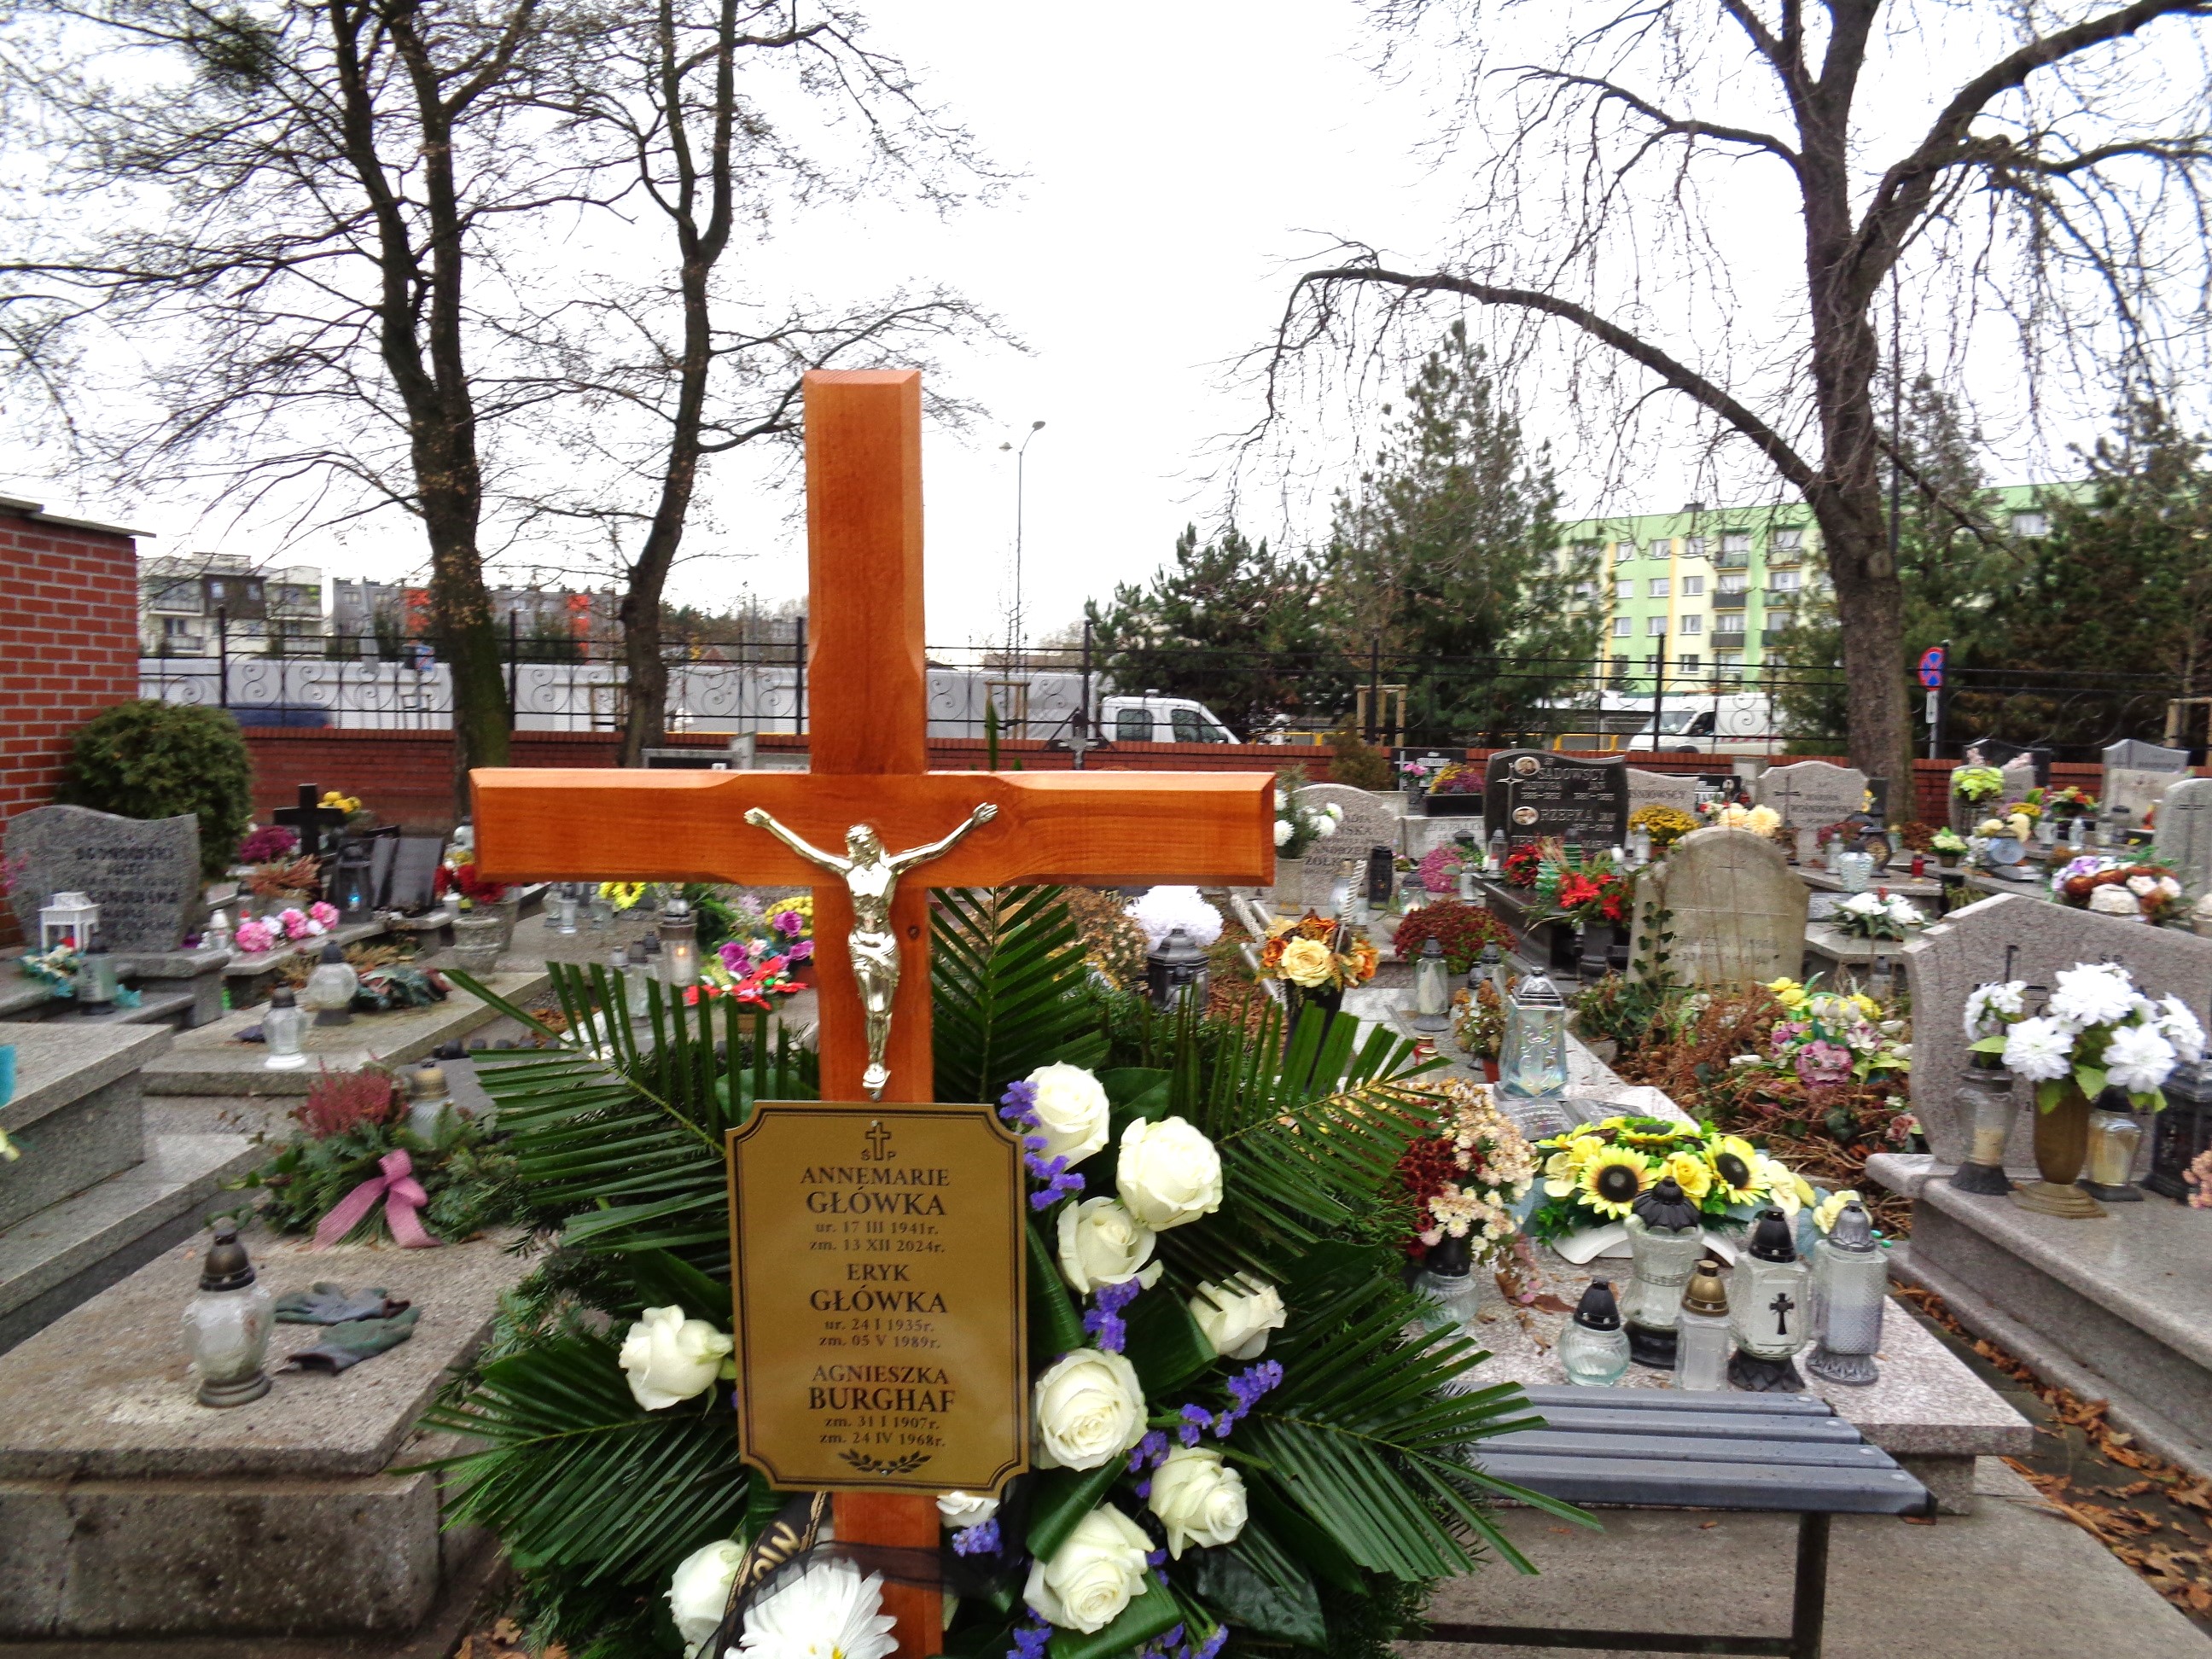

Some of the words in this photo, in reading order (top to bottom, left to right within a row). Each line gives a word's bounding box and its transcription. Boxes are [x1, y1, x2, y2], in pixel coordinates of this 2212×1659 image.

[800, 1167, 951, 1186] ANNEMARIE
[806, 1186, 947, 1216] GŁÓWKA
[815, 1222, 835, 1234] ur.
[843, 1221, 859, 1234] 17
[866, 1221, 883, 1234] III
[892, 1221, 939, 1235] 1941r.
[810, 1240, 836, 1252] zm.
[844, 1239, 860, 1252] 13
[866, 1239, 890, 1252] XII
[897, 1240, 945, 1253] 2024r.
[847, 1263, 910, 1282] ERYK
[810, 1284, 947, 1313] GŁÓWKA
[824, 1320, 846, 1330] ur.
[851, 1318, 869, 1330] 24
[875, 1318, 882, 1330] I
[888, 1318, 934, 1332] 1935r.
[819, 1336, 847, 1347] zm.
[852, 1335, 870, 1347] 05
[876, 1334, 888, 1347] V
[894, 1336, 940, 1348] 1989r.
[812, 1365, 949, 1384] AGNIESZKA
[808, 1386, 956, 1412] BURGHAF
[824, 1417, 852, 1428] zm.
[859, 1415, 874, 1427] 31
[881, 1415, 887, 1427] I
[894, 1416, 940, 1429] 1907r.
[819, 1434, 847, 1443] zm.
[853, 1432, 870, 1443] 24
[876, 1432, 894, 1444] IV
[899, 1433, 946, 1447] 1968r.
